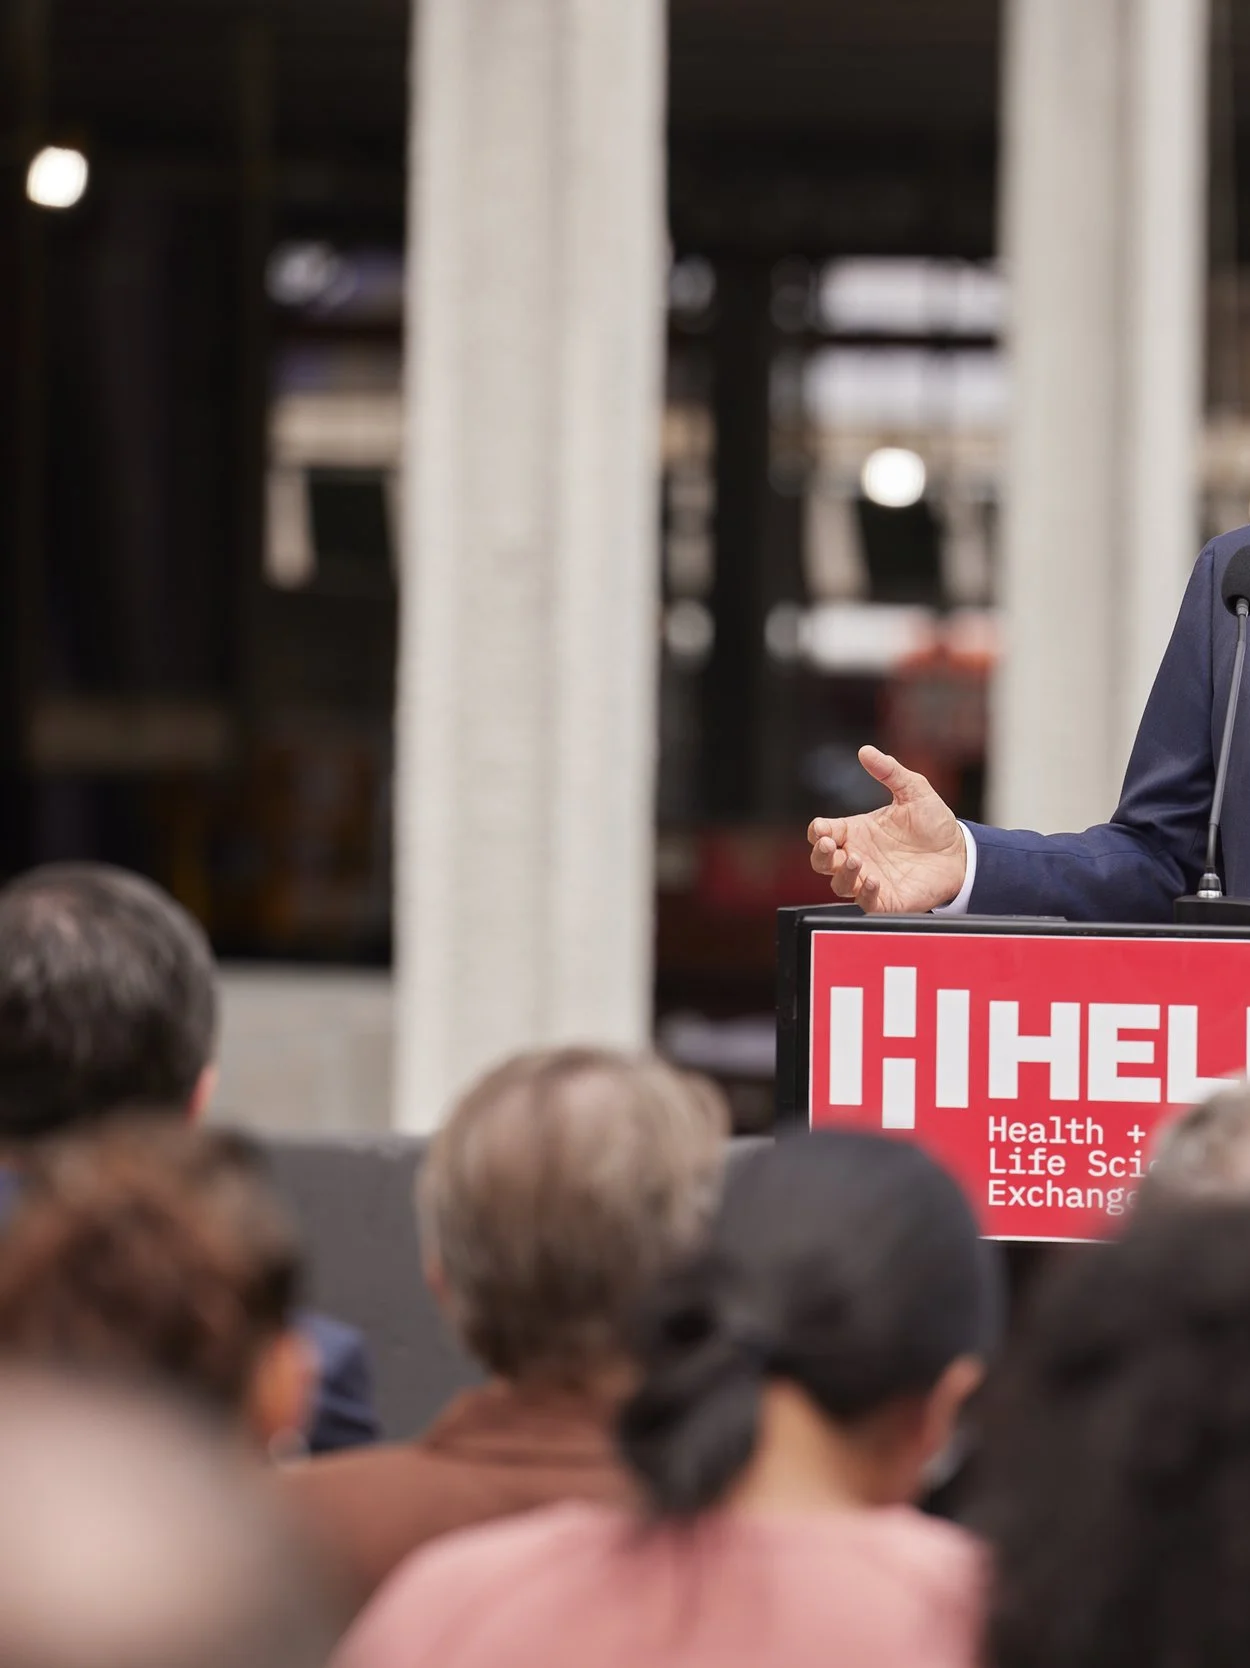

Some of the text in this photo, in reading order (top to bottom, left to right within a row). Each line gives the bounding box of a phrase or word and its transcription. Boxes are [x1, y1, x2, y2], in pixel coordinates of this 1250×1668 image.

[988, 1115, 1146, 1144] Health +
[989, 1147, 1157, 1178] Life Sci
